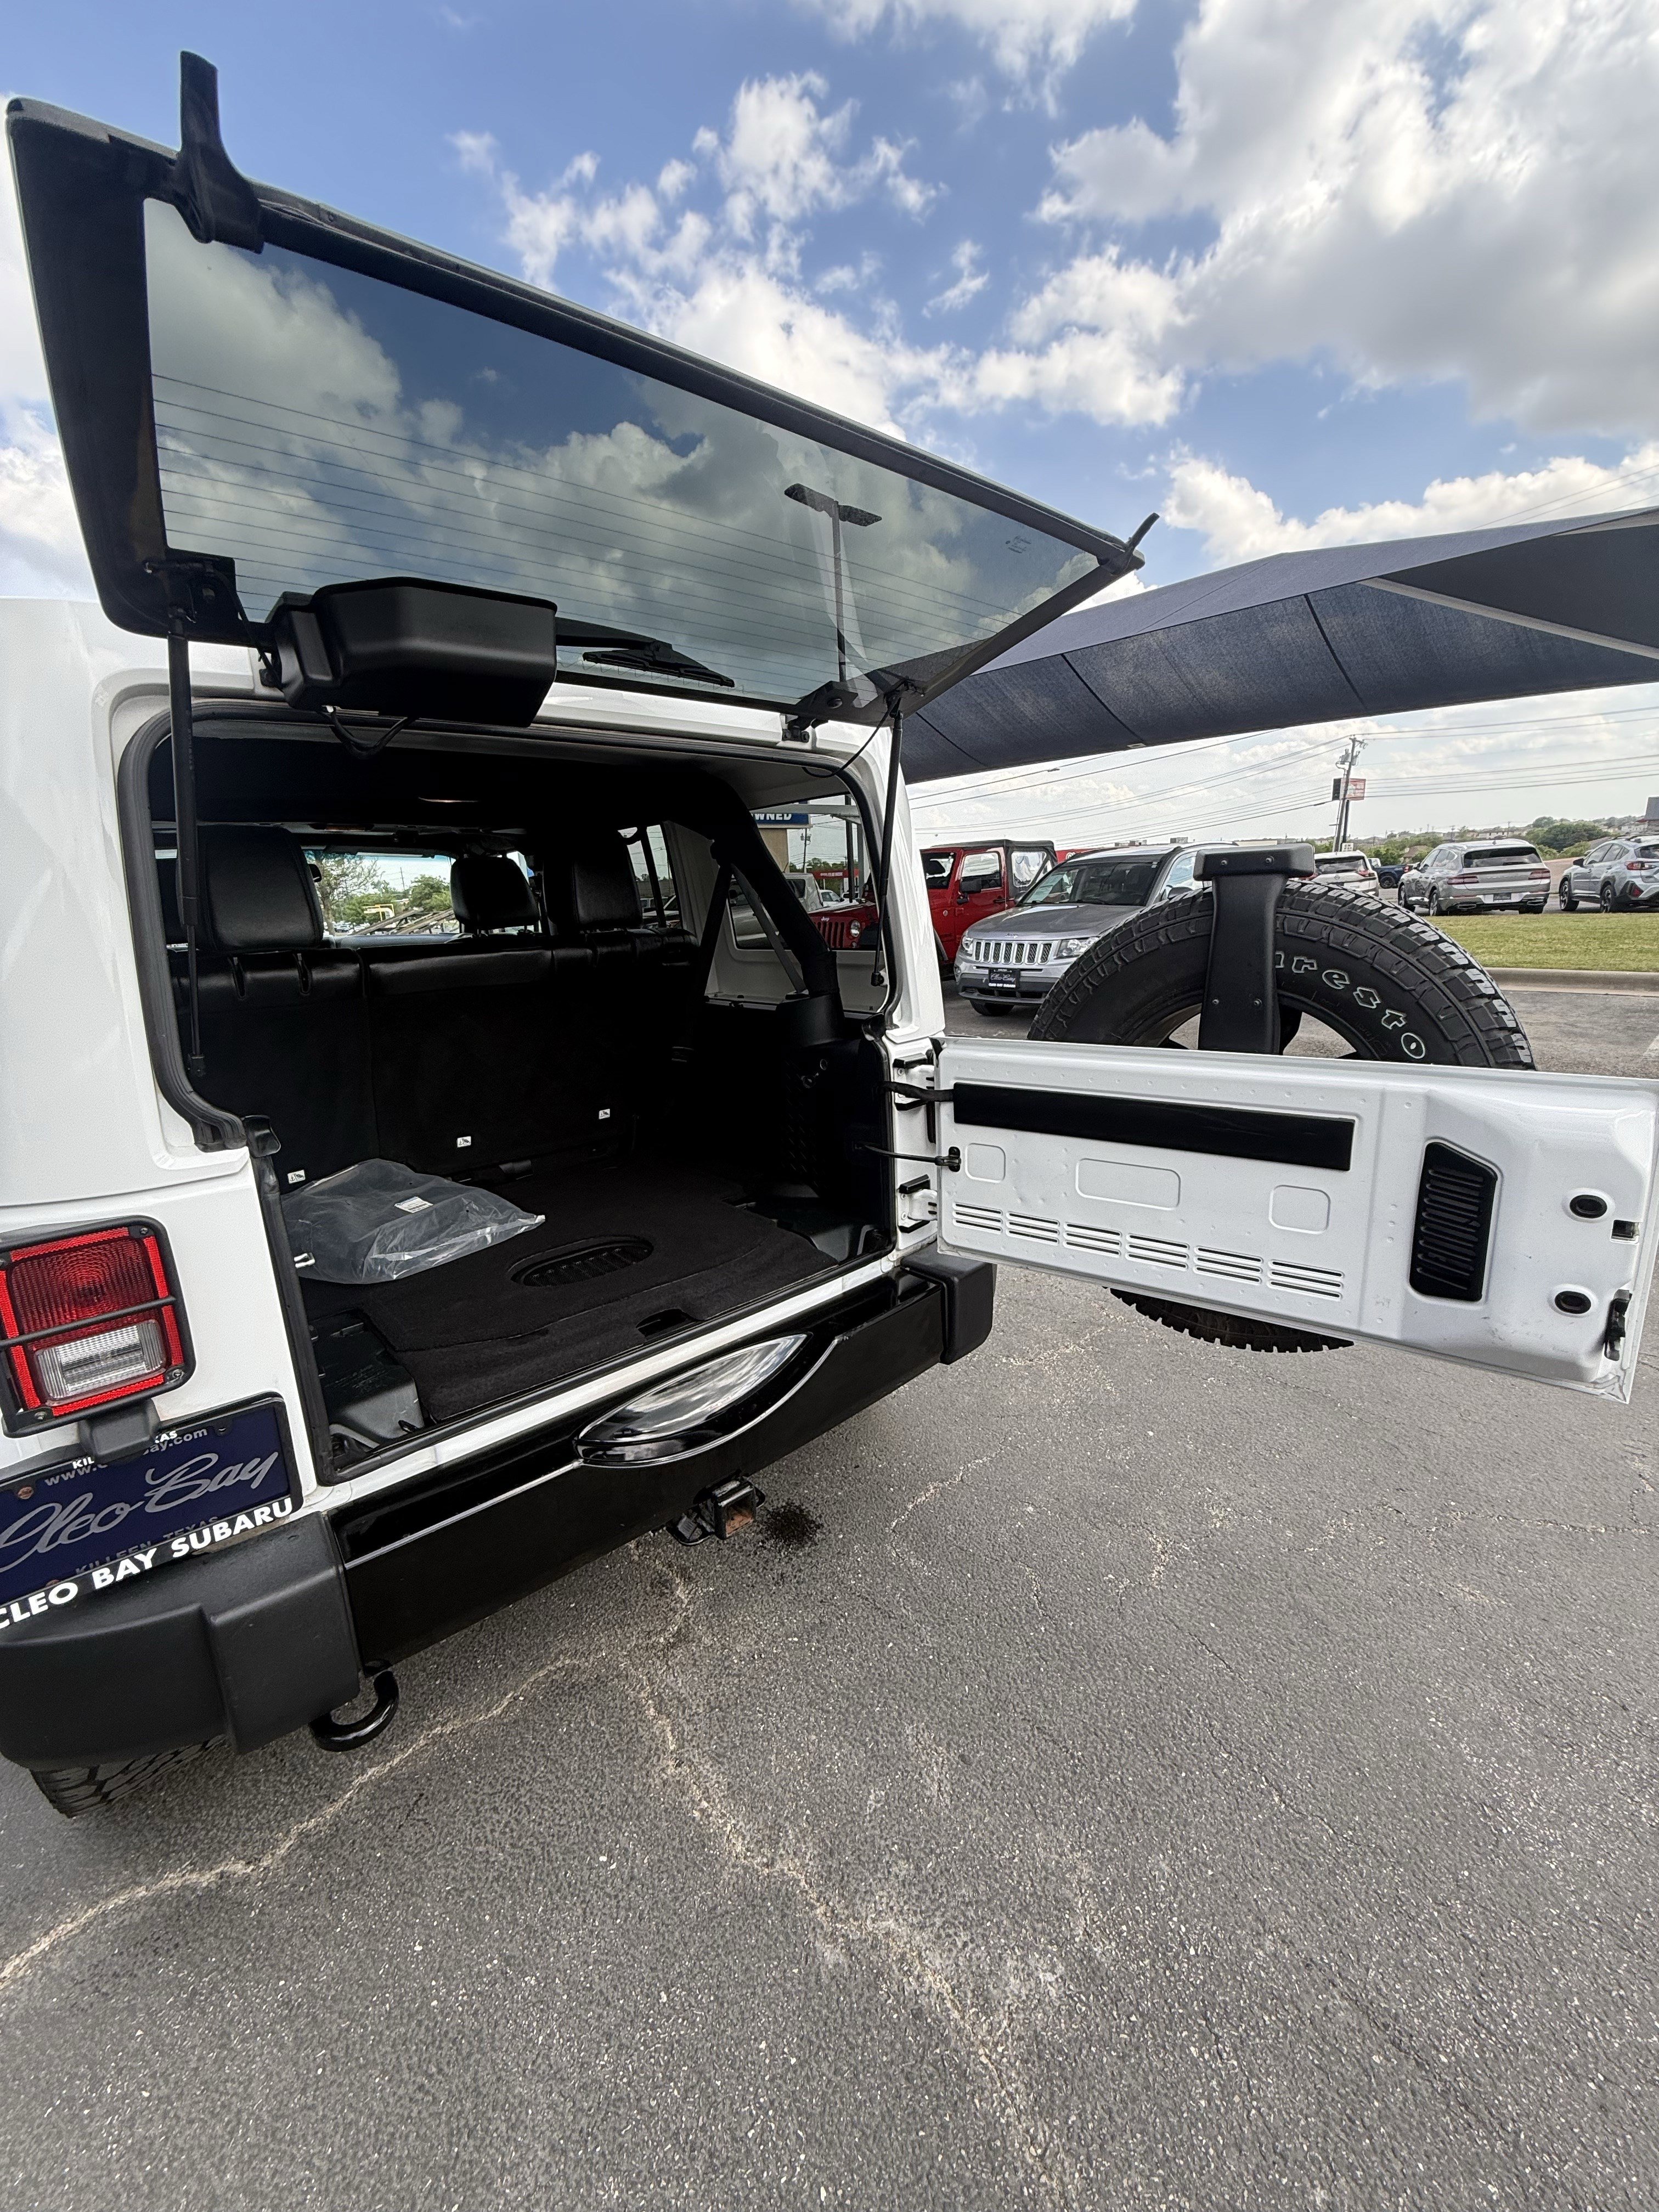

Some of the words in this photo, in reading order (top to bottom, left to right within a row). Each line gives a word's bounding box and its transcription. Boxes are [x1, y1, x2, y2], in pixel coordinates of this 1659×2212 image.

[1275, 951, 1426, 1059] iresto
[144, 1452, 279, 1513] Bay
[92, 1548, 157, 1589] BAY
[171, 1497, 293, 1558] SUBARU
